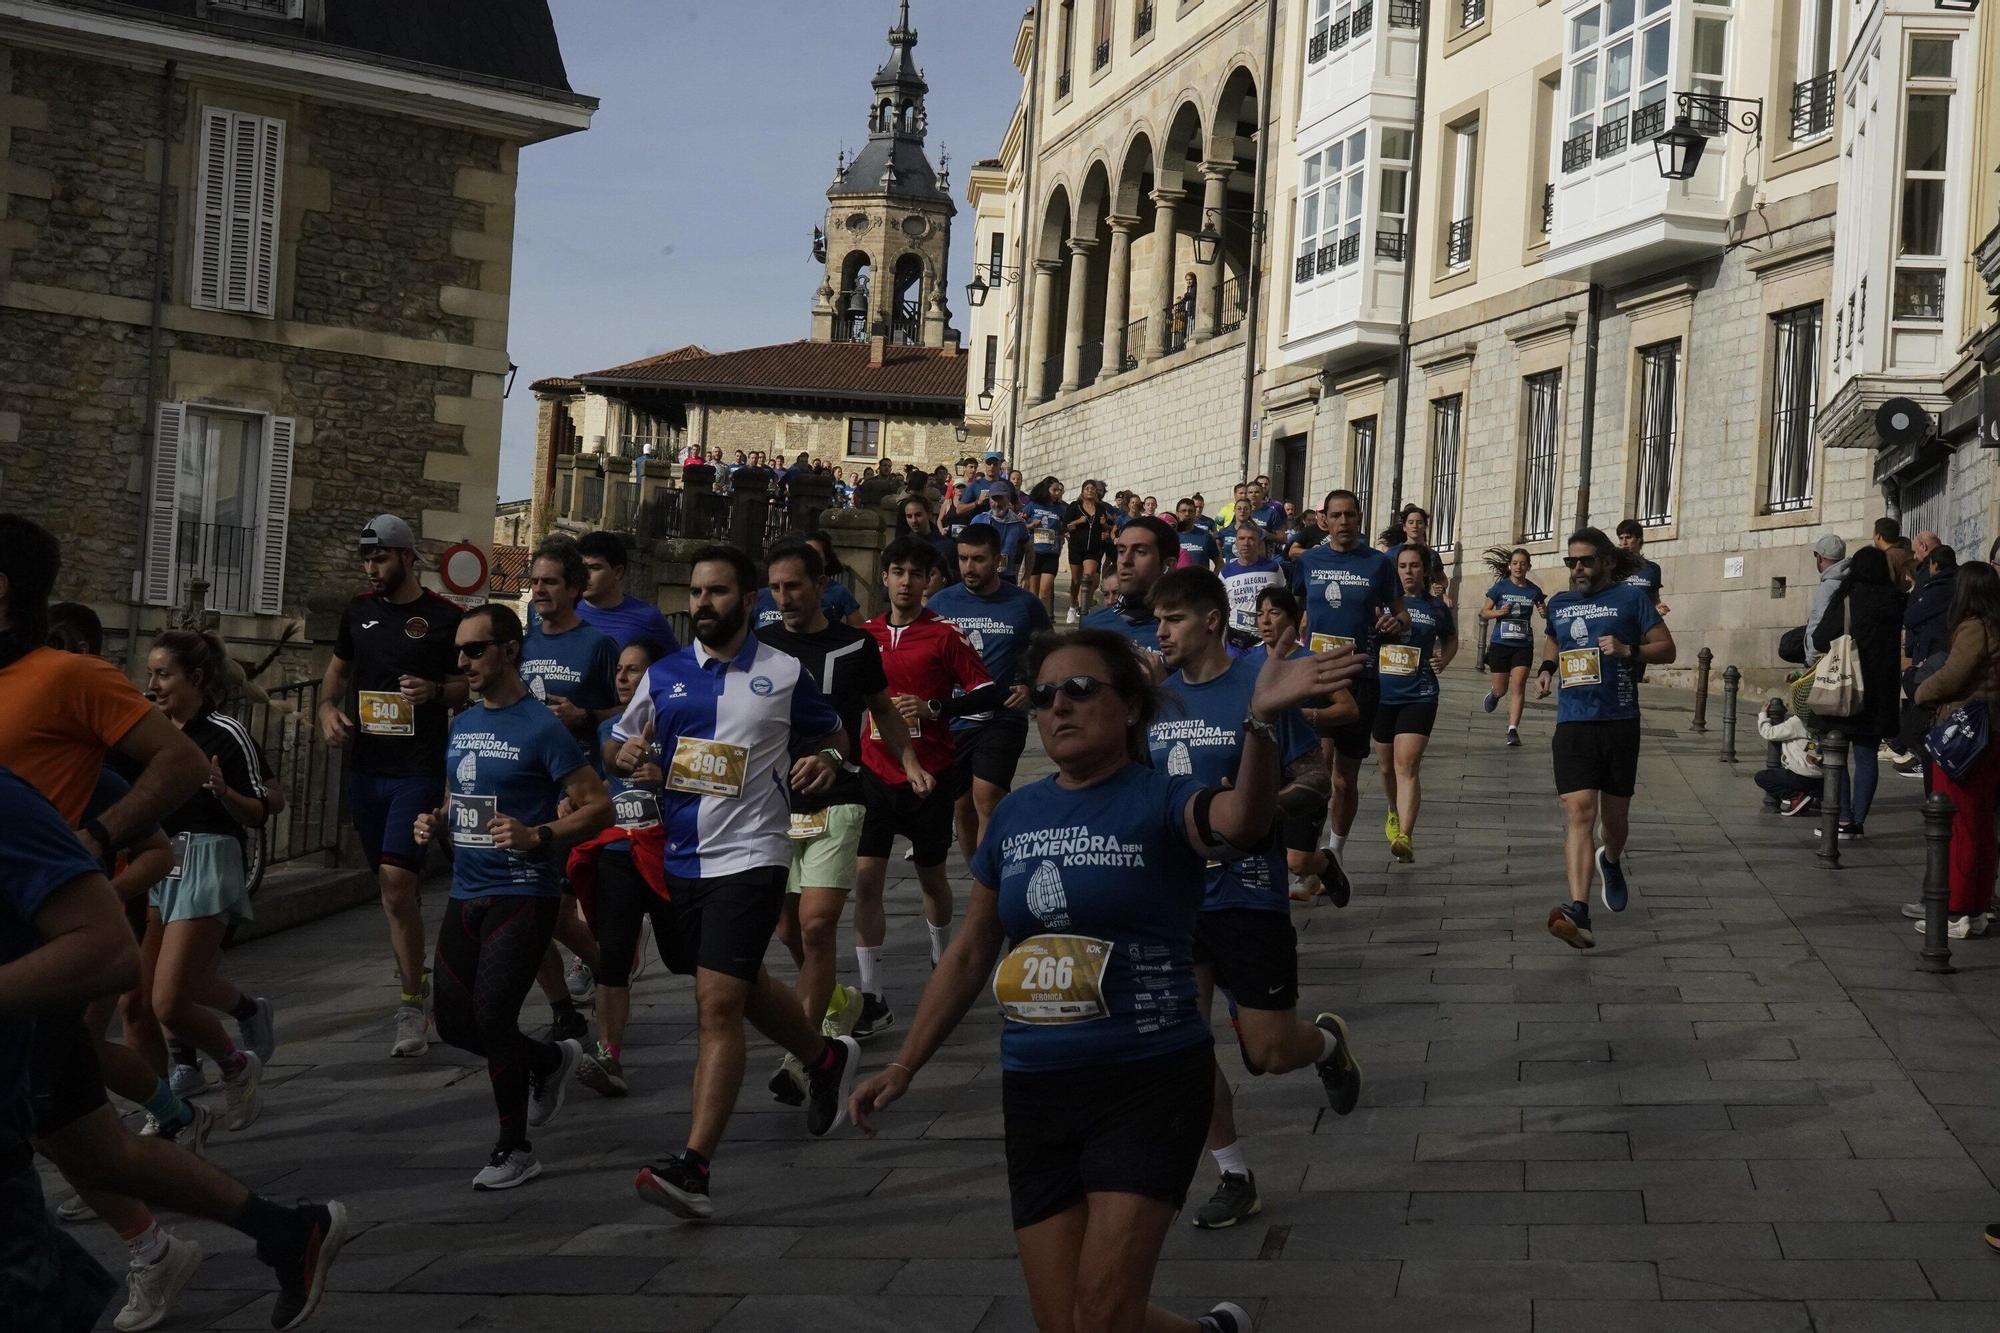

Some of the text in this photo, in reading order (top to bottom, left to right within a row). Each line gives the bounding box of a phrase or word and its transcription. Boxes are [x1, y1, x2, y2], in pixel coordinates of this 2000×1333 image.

[1244, 577, 1268, 585] ALEGRIA
[1567, 658, 1587, 673] 698
[372, 703, 399, 719] 540
[1158, 720, 1205, 730] CONQUISTA
[459, 732, 495, 741] CONQUISTA
[1157, 727, 1222, 741] ALMENDRA
[455, 739, 508, 751] ALMENDRA
[1190, 737, 1236, 747] KONKISTA
[479, 750, 519, 760] KONKISTA
[690, 752, 728, 777] 396
[615, 801, 644, 818] 980
[457, 807, 479, 828] 769
[1002, 825, 1088, 851] LA CONQUISTA
[1013, 835, 1121, 862] ALMENDRA
[1122, 844, 1142, 853] REN
[1063, 853, 1145, 868] KONKISTA
[1086, 945, 1102, 954] 10K
[1021, 956, 1074, 990] 266
